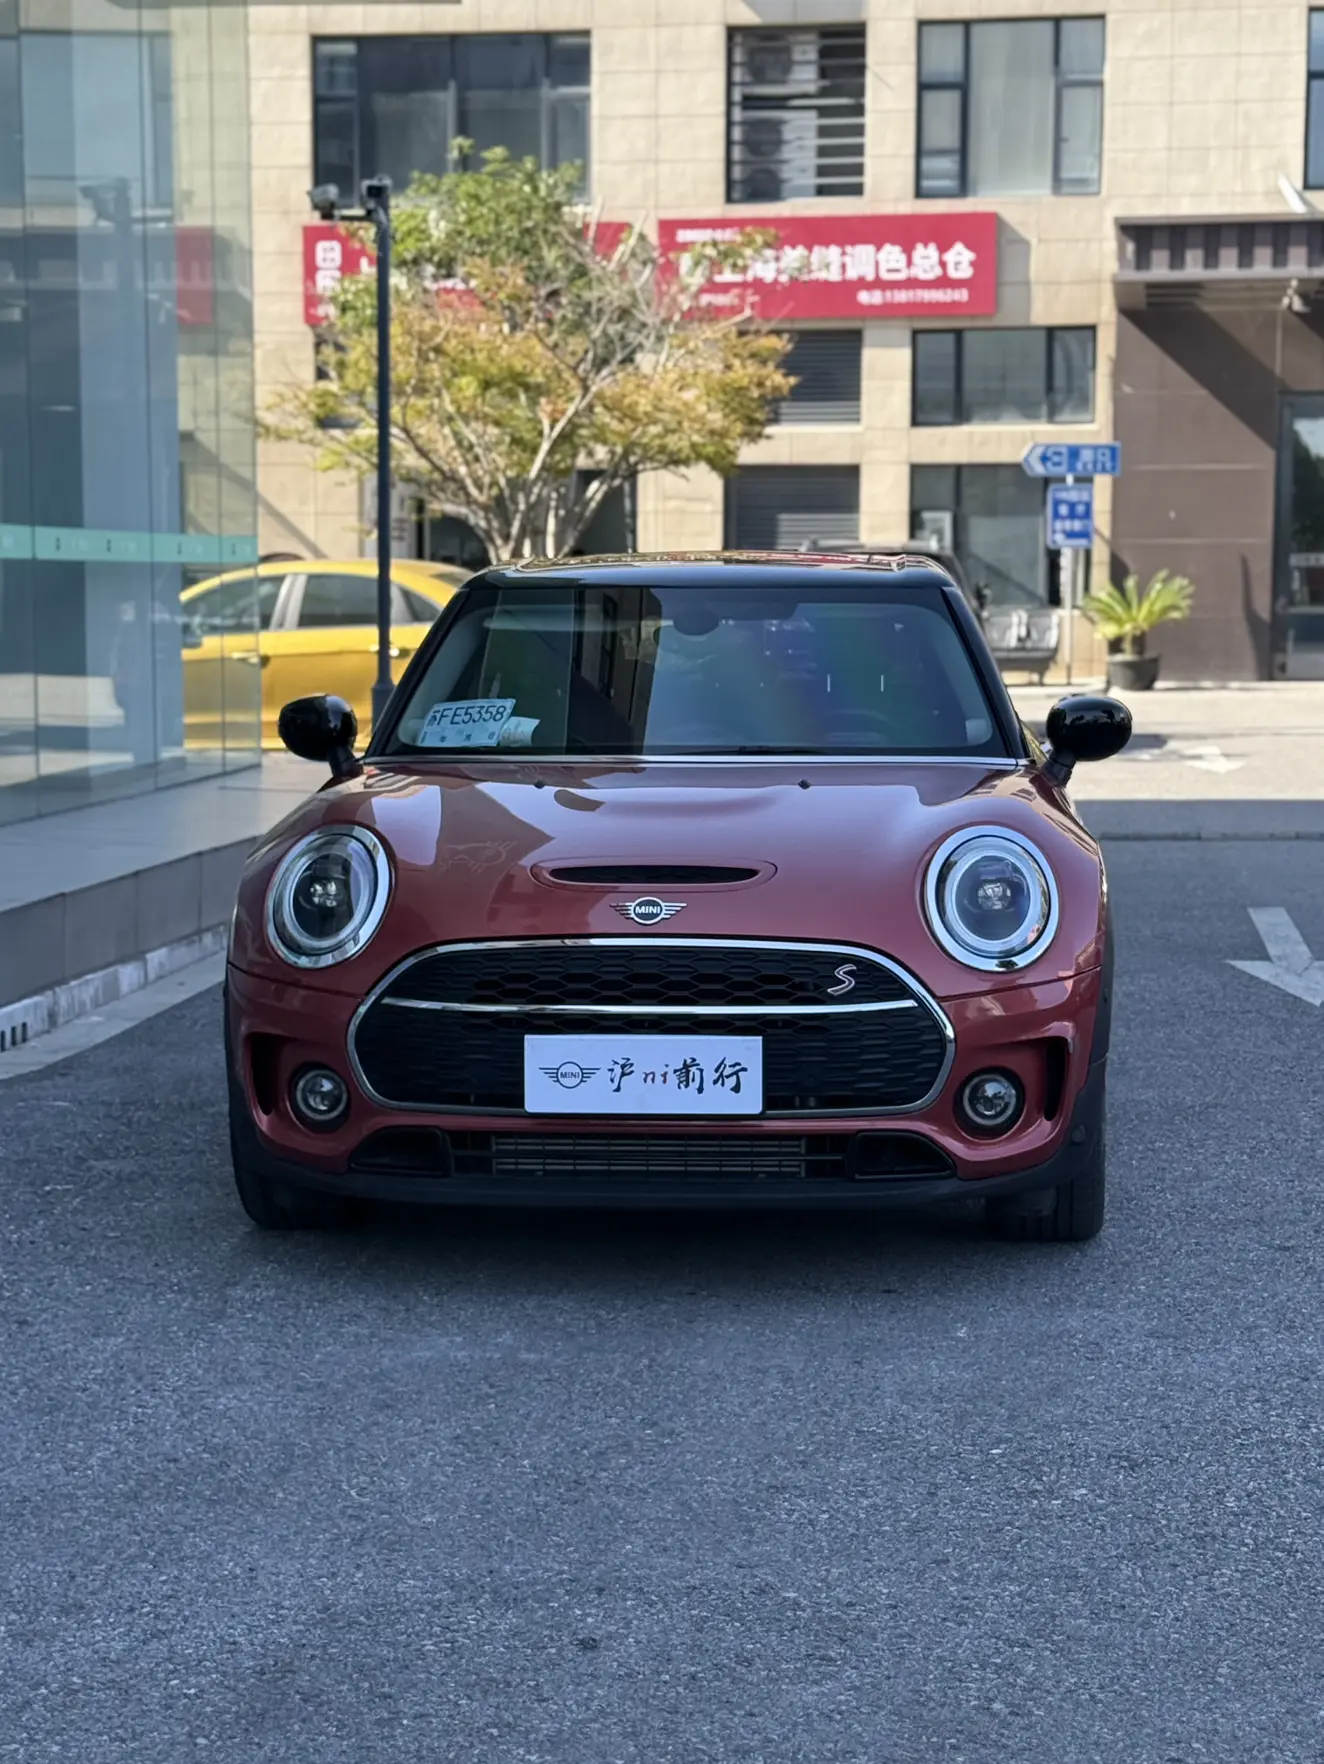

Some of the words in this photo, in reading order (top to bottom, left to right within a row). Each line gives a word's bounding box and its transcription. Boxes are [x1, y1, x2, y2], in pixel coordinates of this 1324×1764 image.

[635, 905, 661, 914] MINI
[827, 963, 857, 996] S
[559, 1071, 580, 1079] MINI
